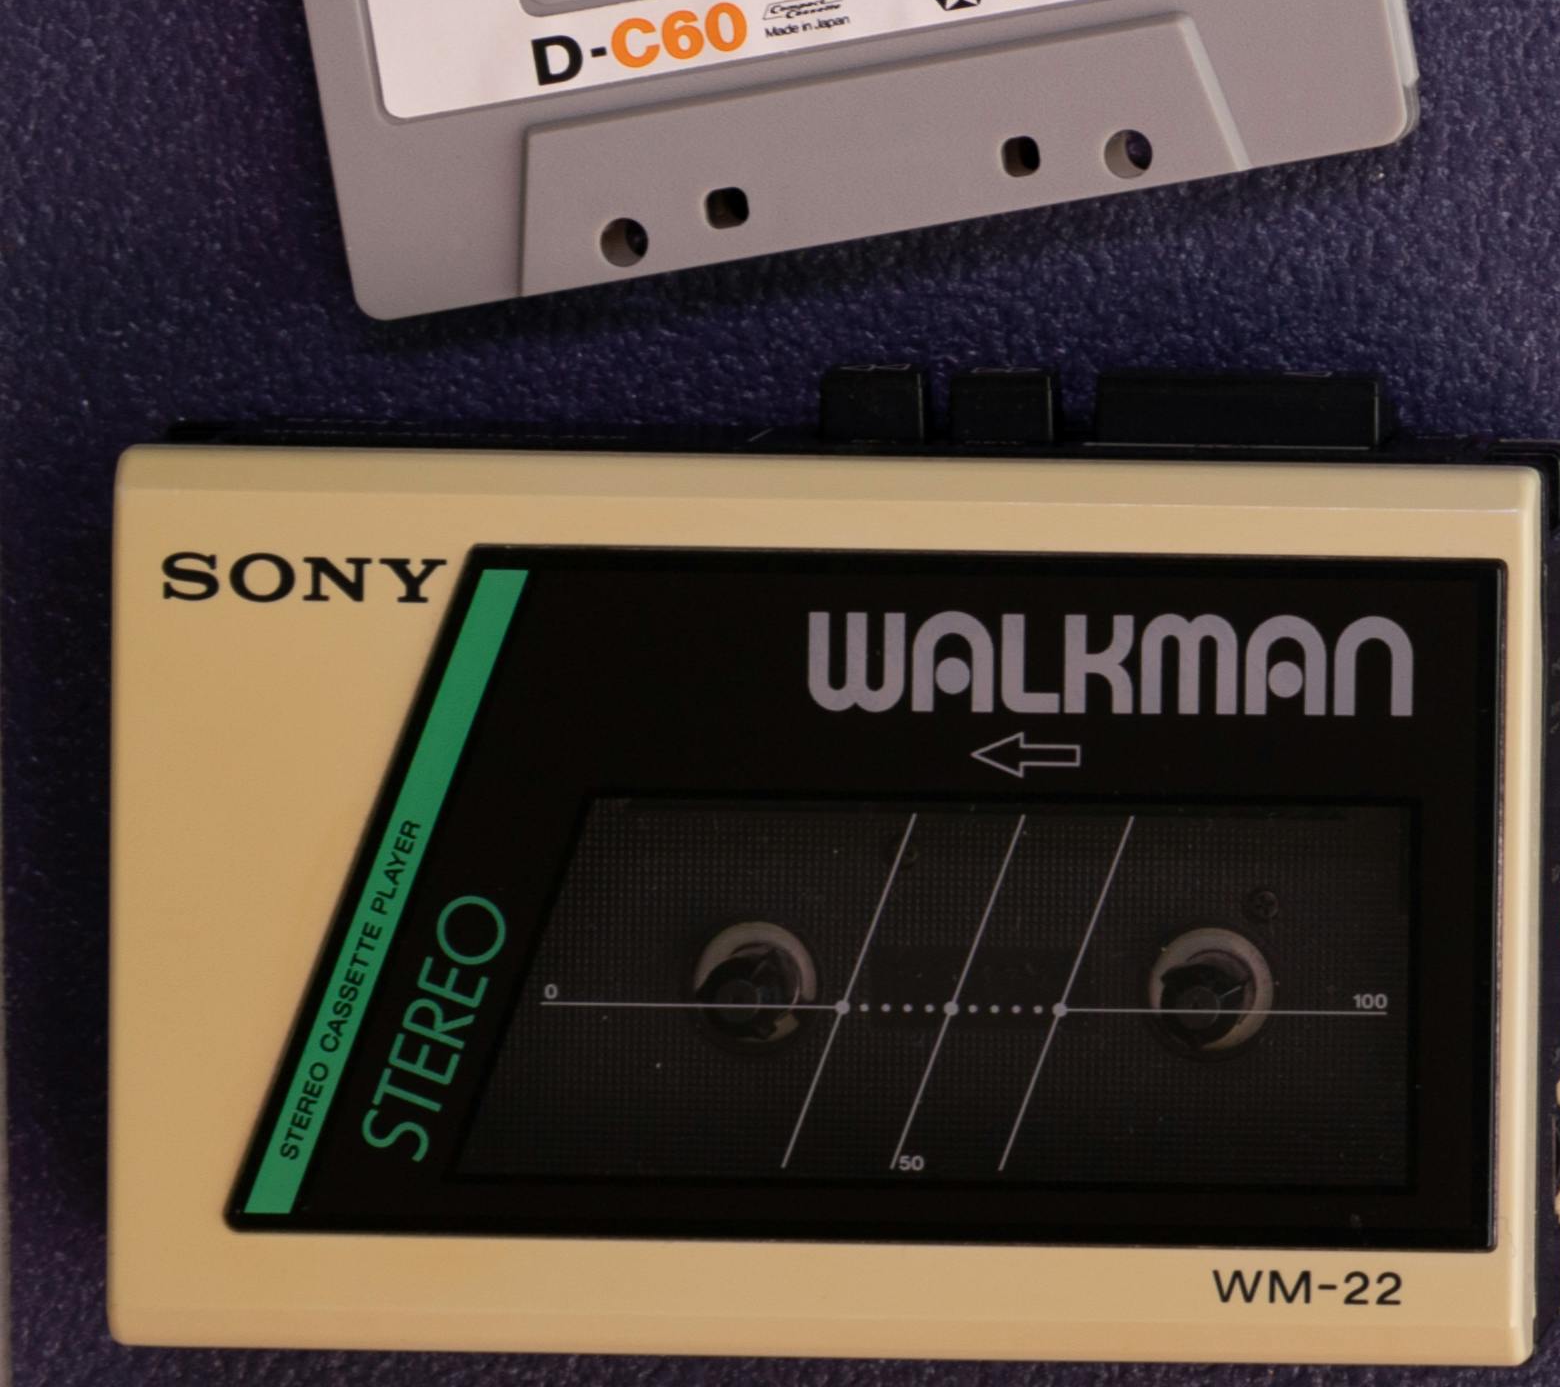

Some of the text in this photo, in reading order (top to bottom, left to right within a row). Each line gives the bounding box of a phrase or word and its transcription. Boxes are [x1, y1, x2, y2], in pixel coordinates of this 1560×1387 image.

[161, 551, 447, 604] SONY
[808, 610, 1414, 717] WALKMAN
[280, 819, 421, 1161] STEREO CASSETTE PLAYER
[1352, 993, 1389, 1010] 100
[361, 894, 507, 1162] STEREO
[898, 1155, 925, 1173] 50
[1212, 1269, 1403, 1306] WM-22
